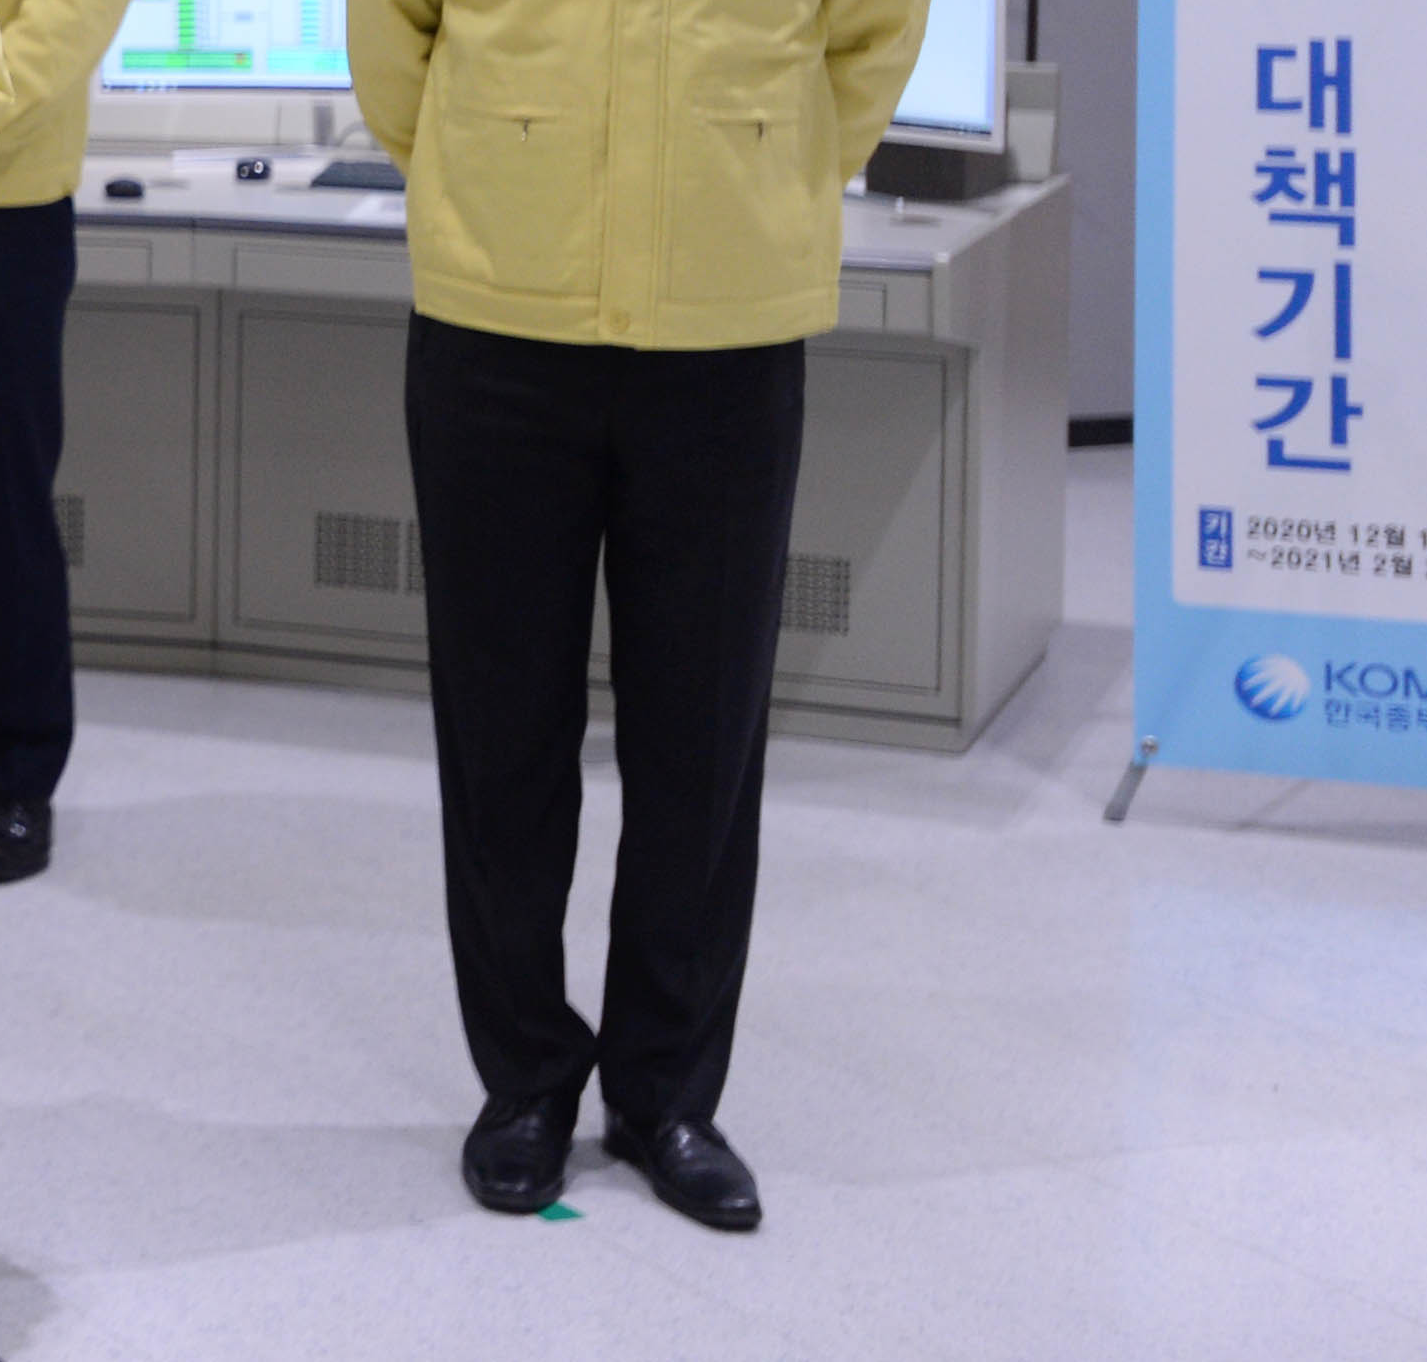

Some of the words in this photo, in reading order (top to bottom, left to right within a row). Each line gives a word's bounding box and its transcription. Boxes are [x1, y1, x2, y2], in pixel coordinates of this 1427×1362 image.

[1253, 36, 1363, 472] 대책기간
[1248, 515, 1337, 544] 2020년
[1350, 523, 1406, 548] 12월
